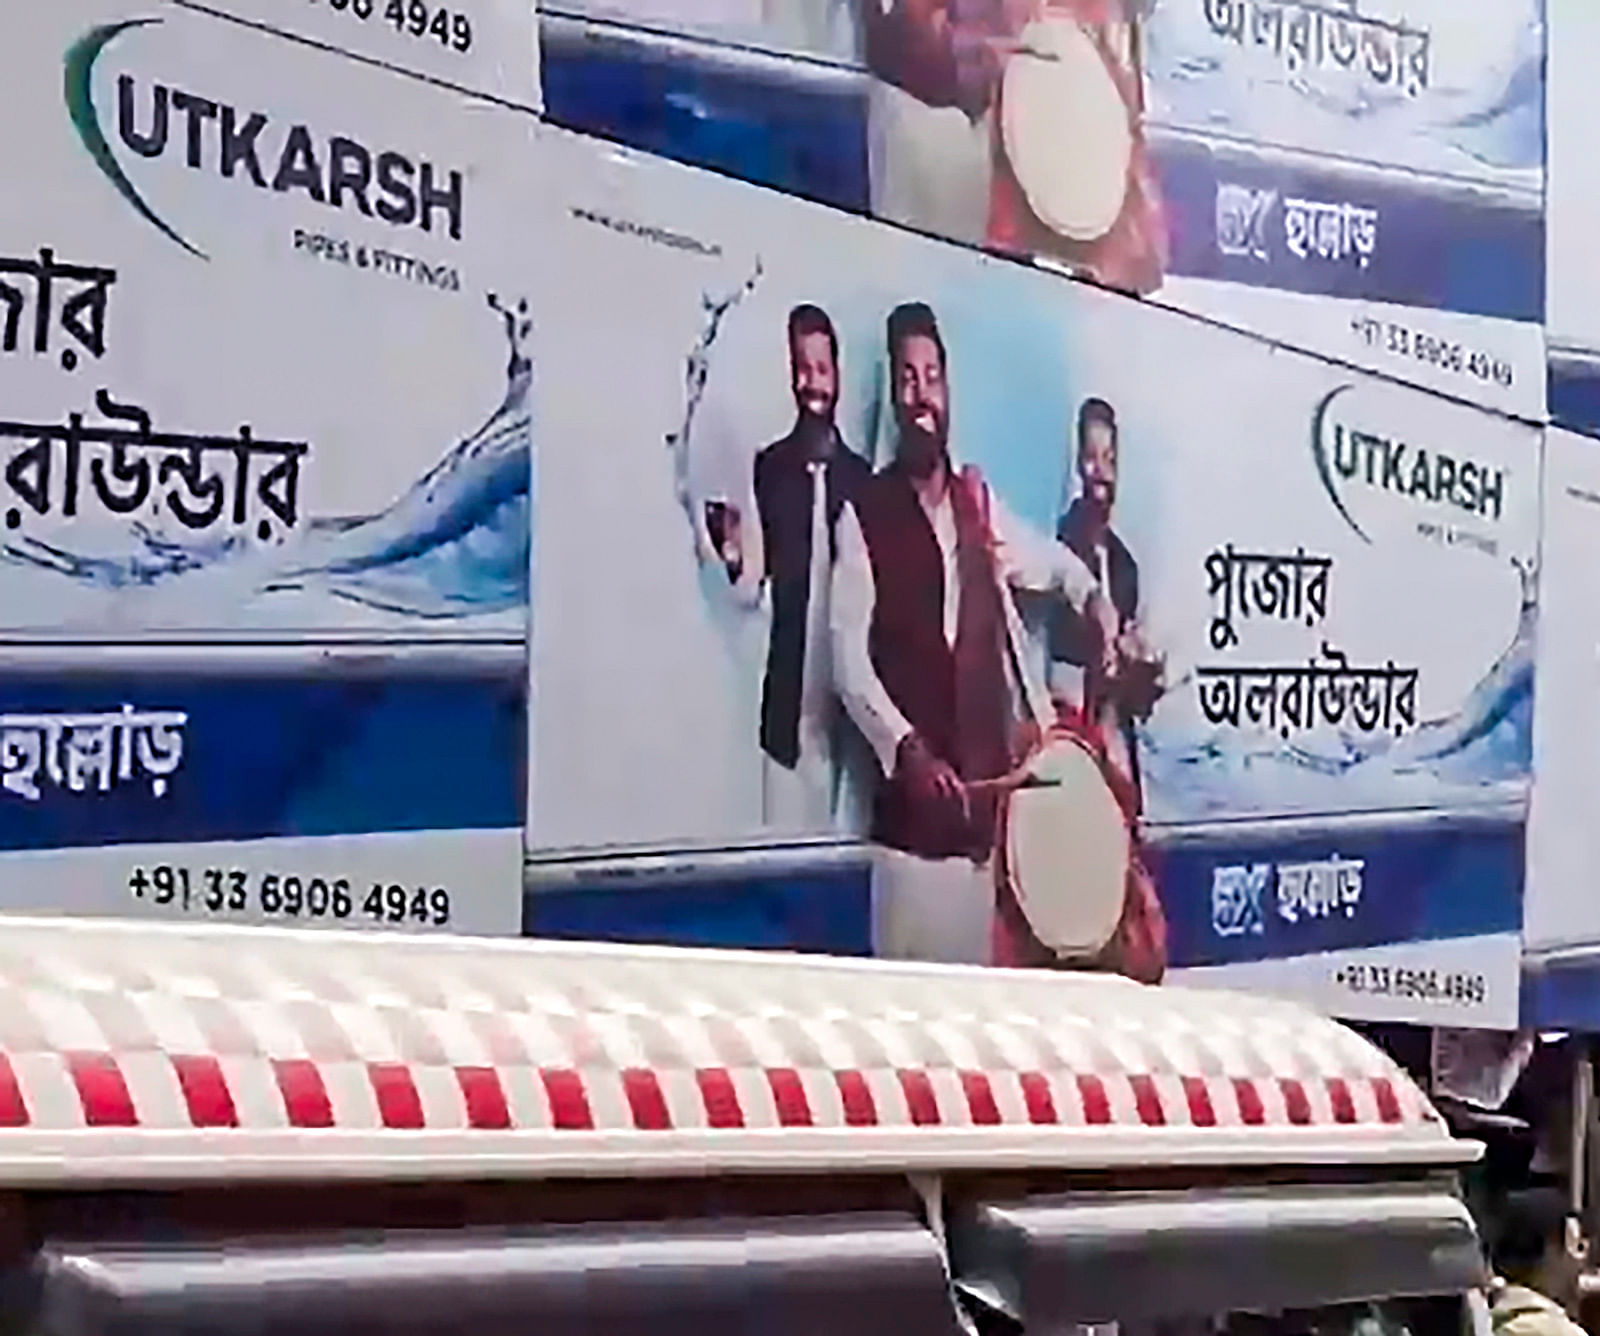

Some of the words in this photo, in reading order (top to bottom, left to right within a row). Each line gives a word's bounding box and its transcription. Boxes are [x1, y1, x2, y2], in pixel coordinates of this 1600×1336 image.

[384, 0, 472, 52] 4949
[118, 73, 463, 241] UTKARSH
[293, 229, 350, 264] PIPES
[373, 249, 461, 291] FITTINGS
[0, 388, 308, 541] রাউন্ডার
[1335, 423, 1503, 521] UTKARSH
[1205, 543, 1332, 650] পুজোর
[1196, 640, 1419, 740] অলরাউন্ডার
[129, 866, 189, 911] +91
[204, 868, 247, 911] 33
[260, 875, 352, 918] 6906
[363, 883, 449, 924] 4949
